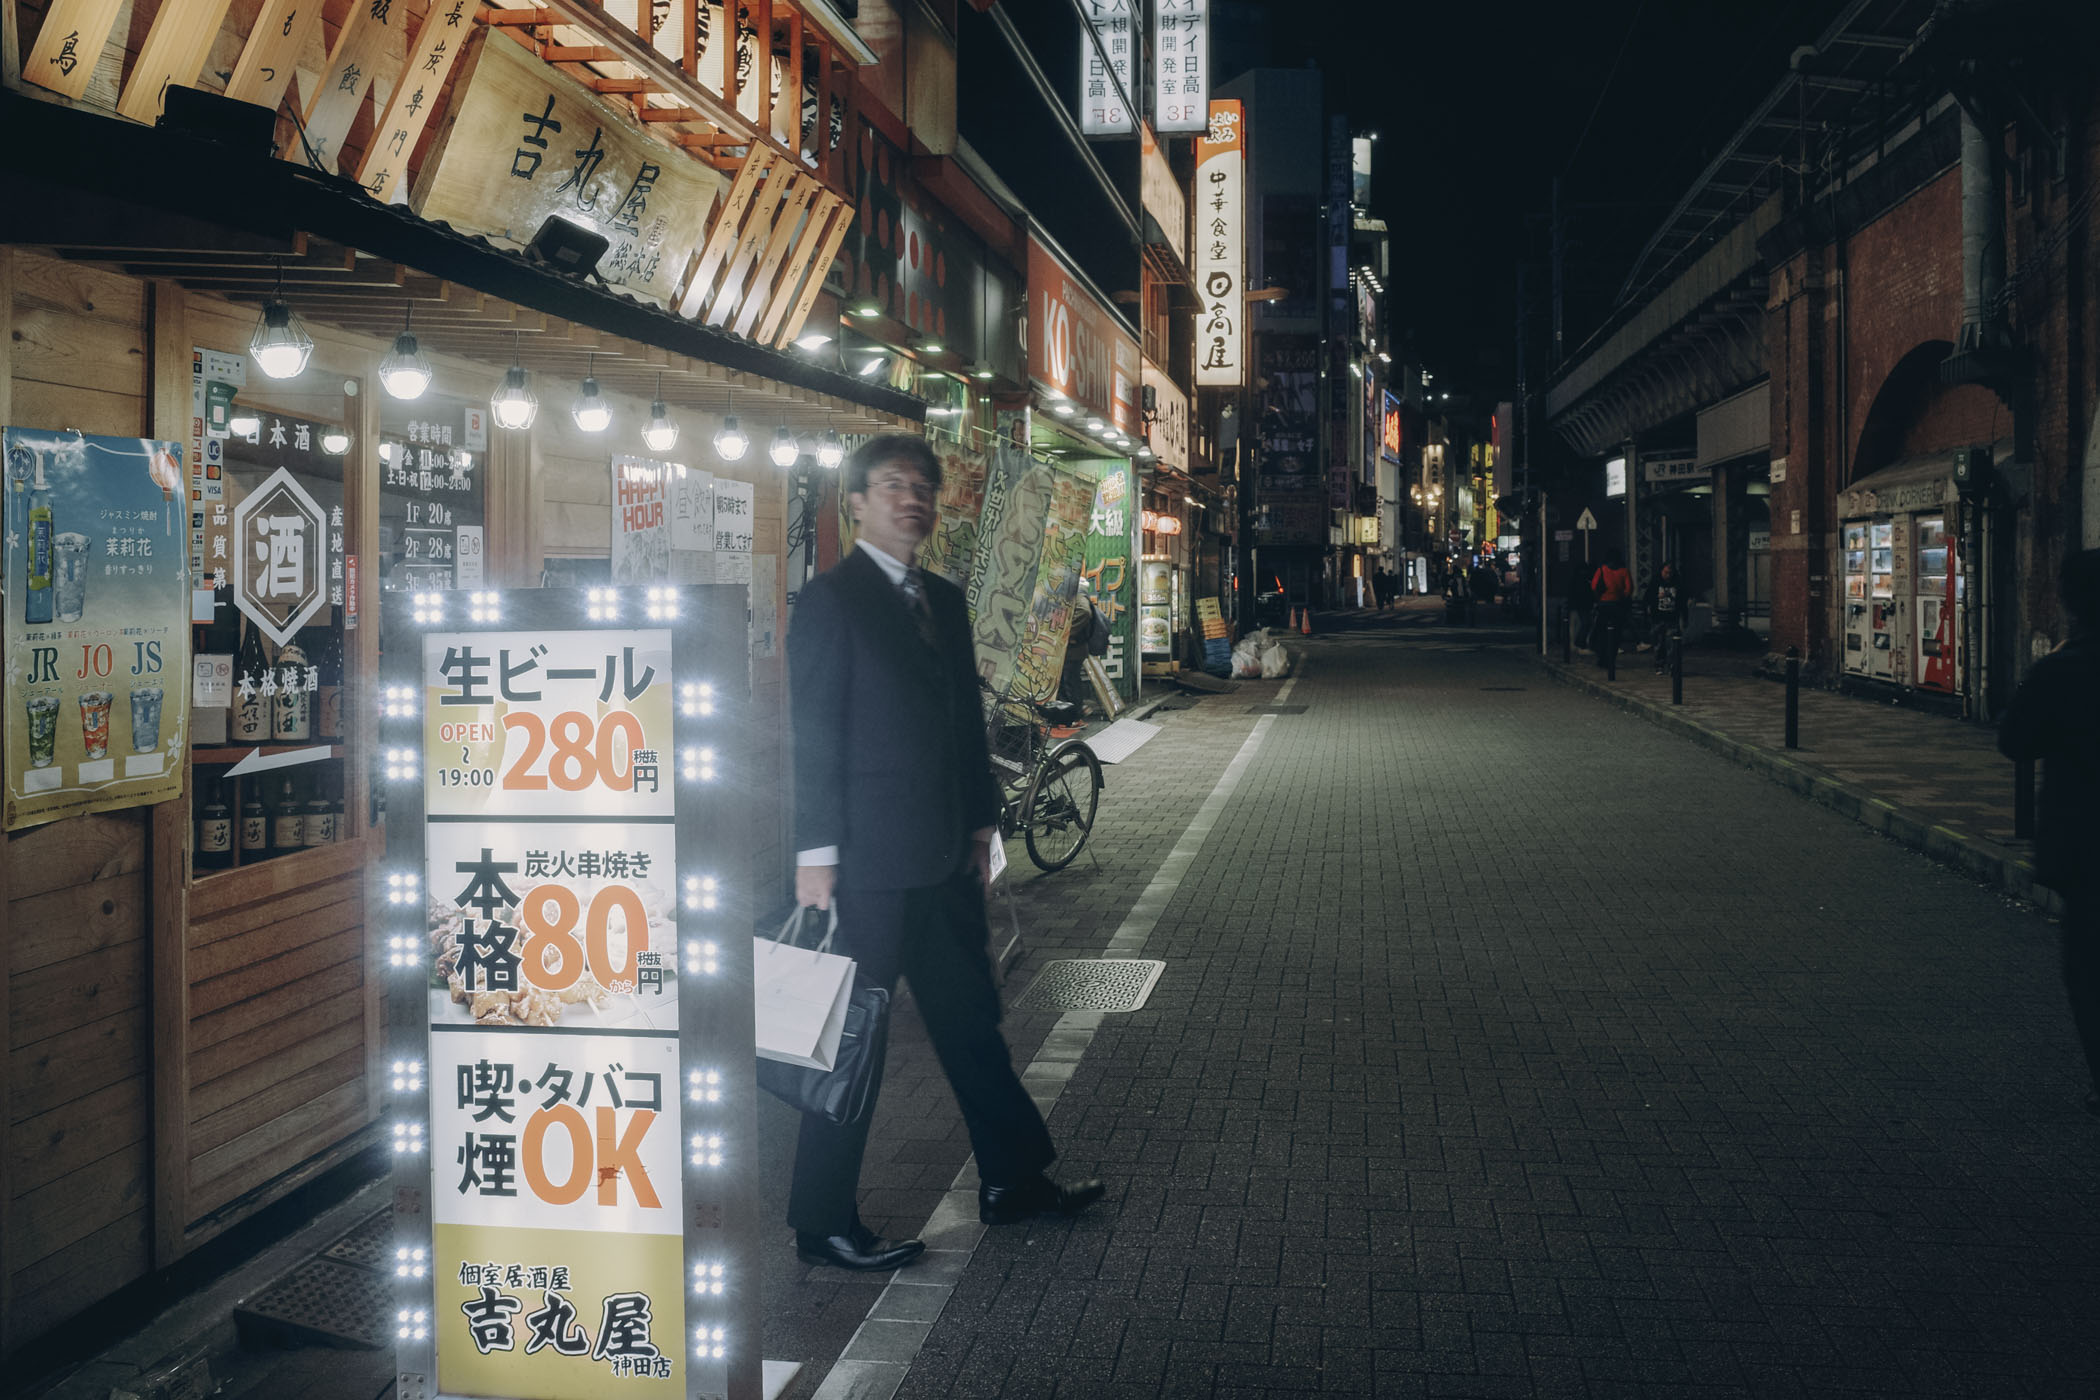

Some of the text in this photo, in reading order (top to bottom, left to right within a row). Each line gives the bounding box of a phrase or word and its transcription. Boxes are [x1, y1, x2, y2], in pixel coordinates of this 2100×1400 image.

[1167, 105, 1196, 121] 3F
[511, 94, 661, 238] 吉丸屋
[1209, 169, 1228, 261] 中華食堂
[407, 420, 452, 446] 営業時間
[207, 486, 222, 495] VISA
[618, 478, 665, 506] HAPPY
[406, 502, 420, 523] 1F
[623, 502, 664, 533] HOUR
[106, 537, 153, 557] 茉莉花
[212, 504, 227, 607] 品質第一
[256, 513, 305, 598] 酒
[331, 505, 343, 606] 産地直送
[405, 537, 420, 559] 2F
[27, 640, 162, 684] JR JO JS
[439, 643, 656, 706] 生ビール
[440, 723, 494, 742] OPEN
[502, 711, 645, 791] 280
[633, 749, 658, 764] 税抜
[438, 768, 494, 787] 19:00
[633, 765, 658, 793] 円
[524, 850, 652, 879] 炭火串焼き
[453, 847, 523, 992] 本格
[521, 884, 649, 992] 80
[637, 951, 661, 966] 税抜
[610, 980, 633, 993] から
[637, 967, 663, 995] 円
[456, 1058, 517, 1197] 喫煙
[521, 1103, 663, 1209] OK
[458, 1261, 571, 1291] 個室居酒屋
[461, 1291, 661, 1362] 吉丸屋
[611, 1355, 673, 1378] 神田店
